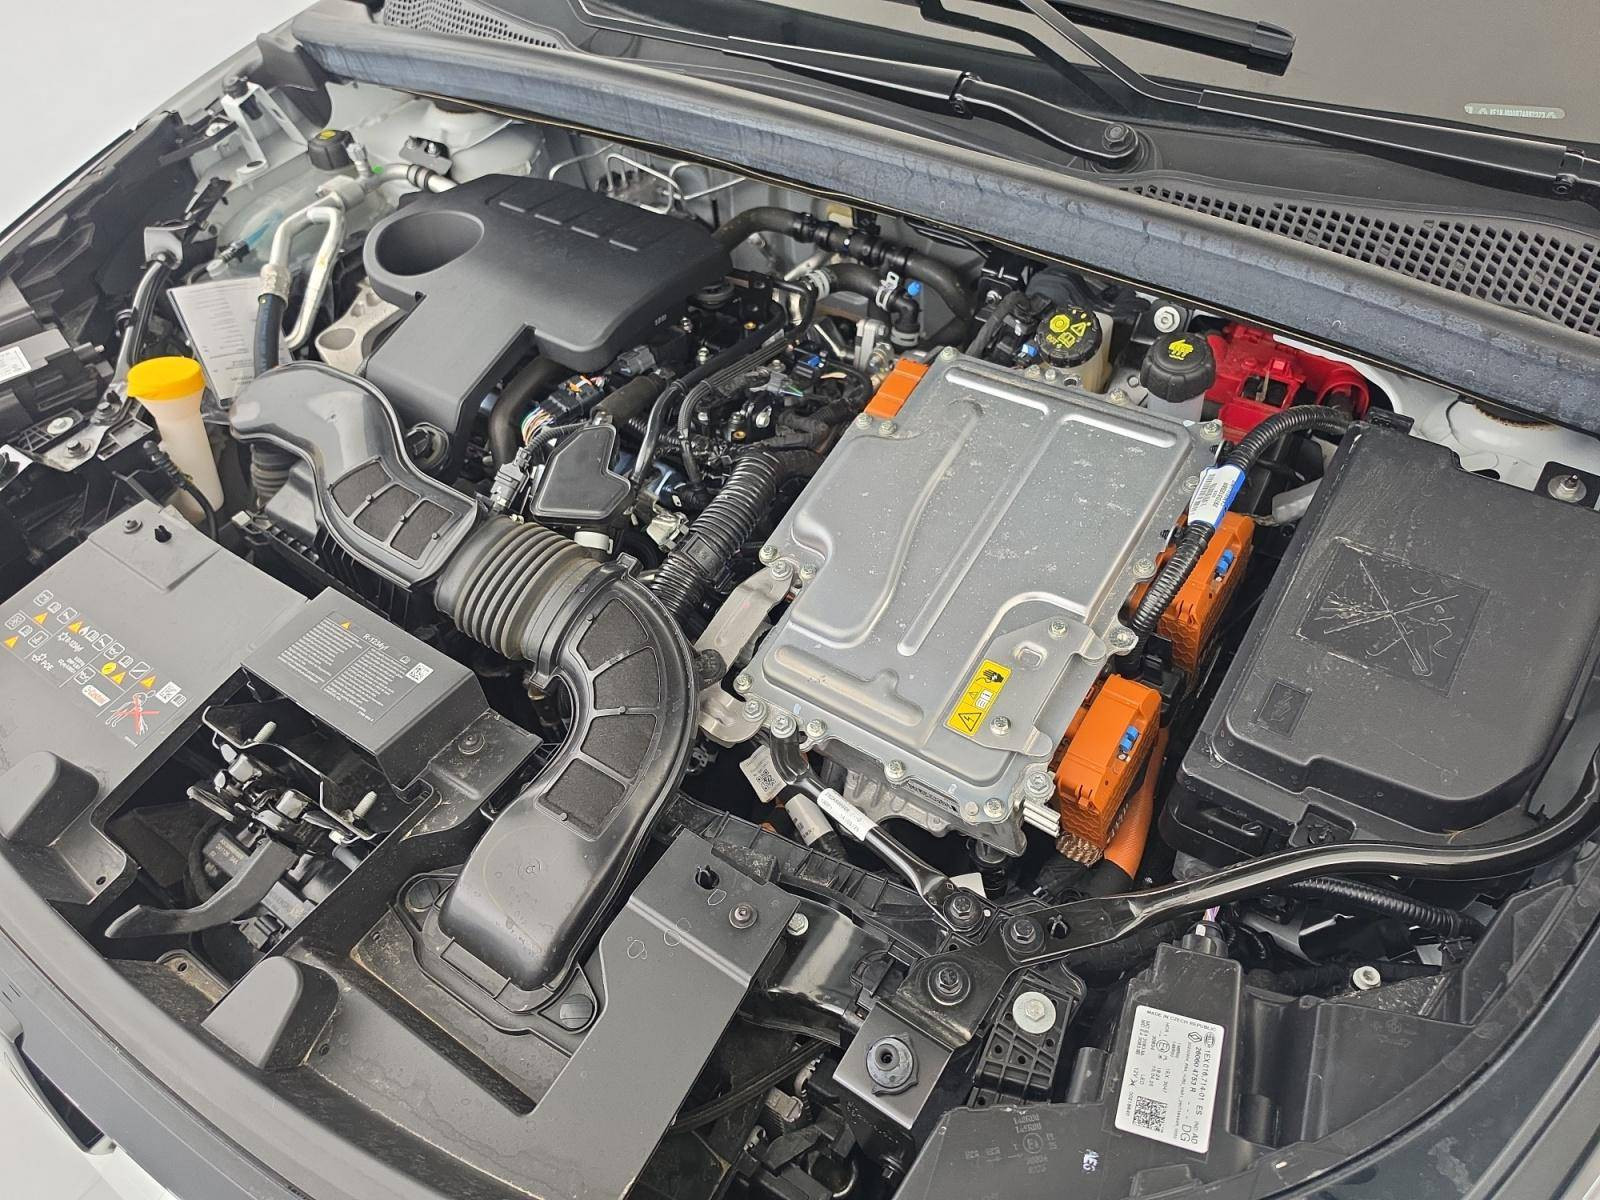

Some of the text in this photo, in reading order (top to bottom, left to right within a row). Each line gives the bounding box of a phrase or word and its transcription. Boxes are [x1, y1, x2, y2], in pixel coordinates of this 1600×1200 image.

[363, 633, 390, 650] R-1234yf
[40, 659, 54, 672] POE
[1170, 1016, 1189, 1024] CZECH
[1190, 1021, 1216, 1030] REPUBLIC
[1196, 1105, 1203, 1115] ES
[1180, 1124, 1192, 1142] DG
